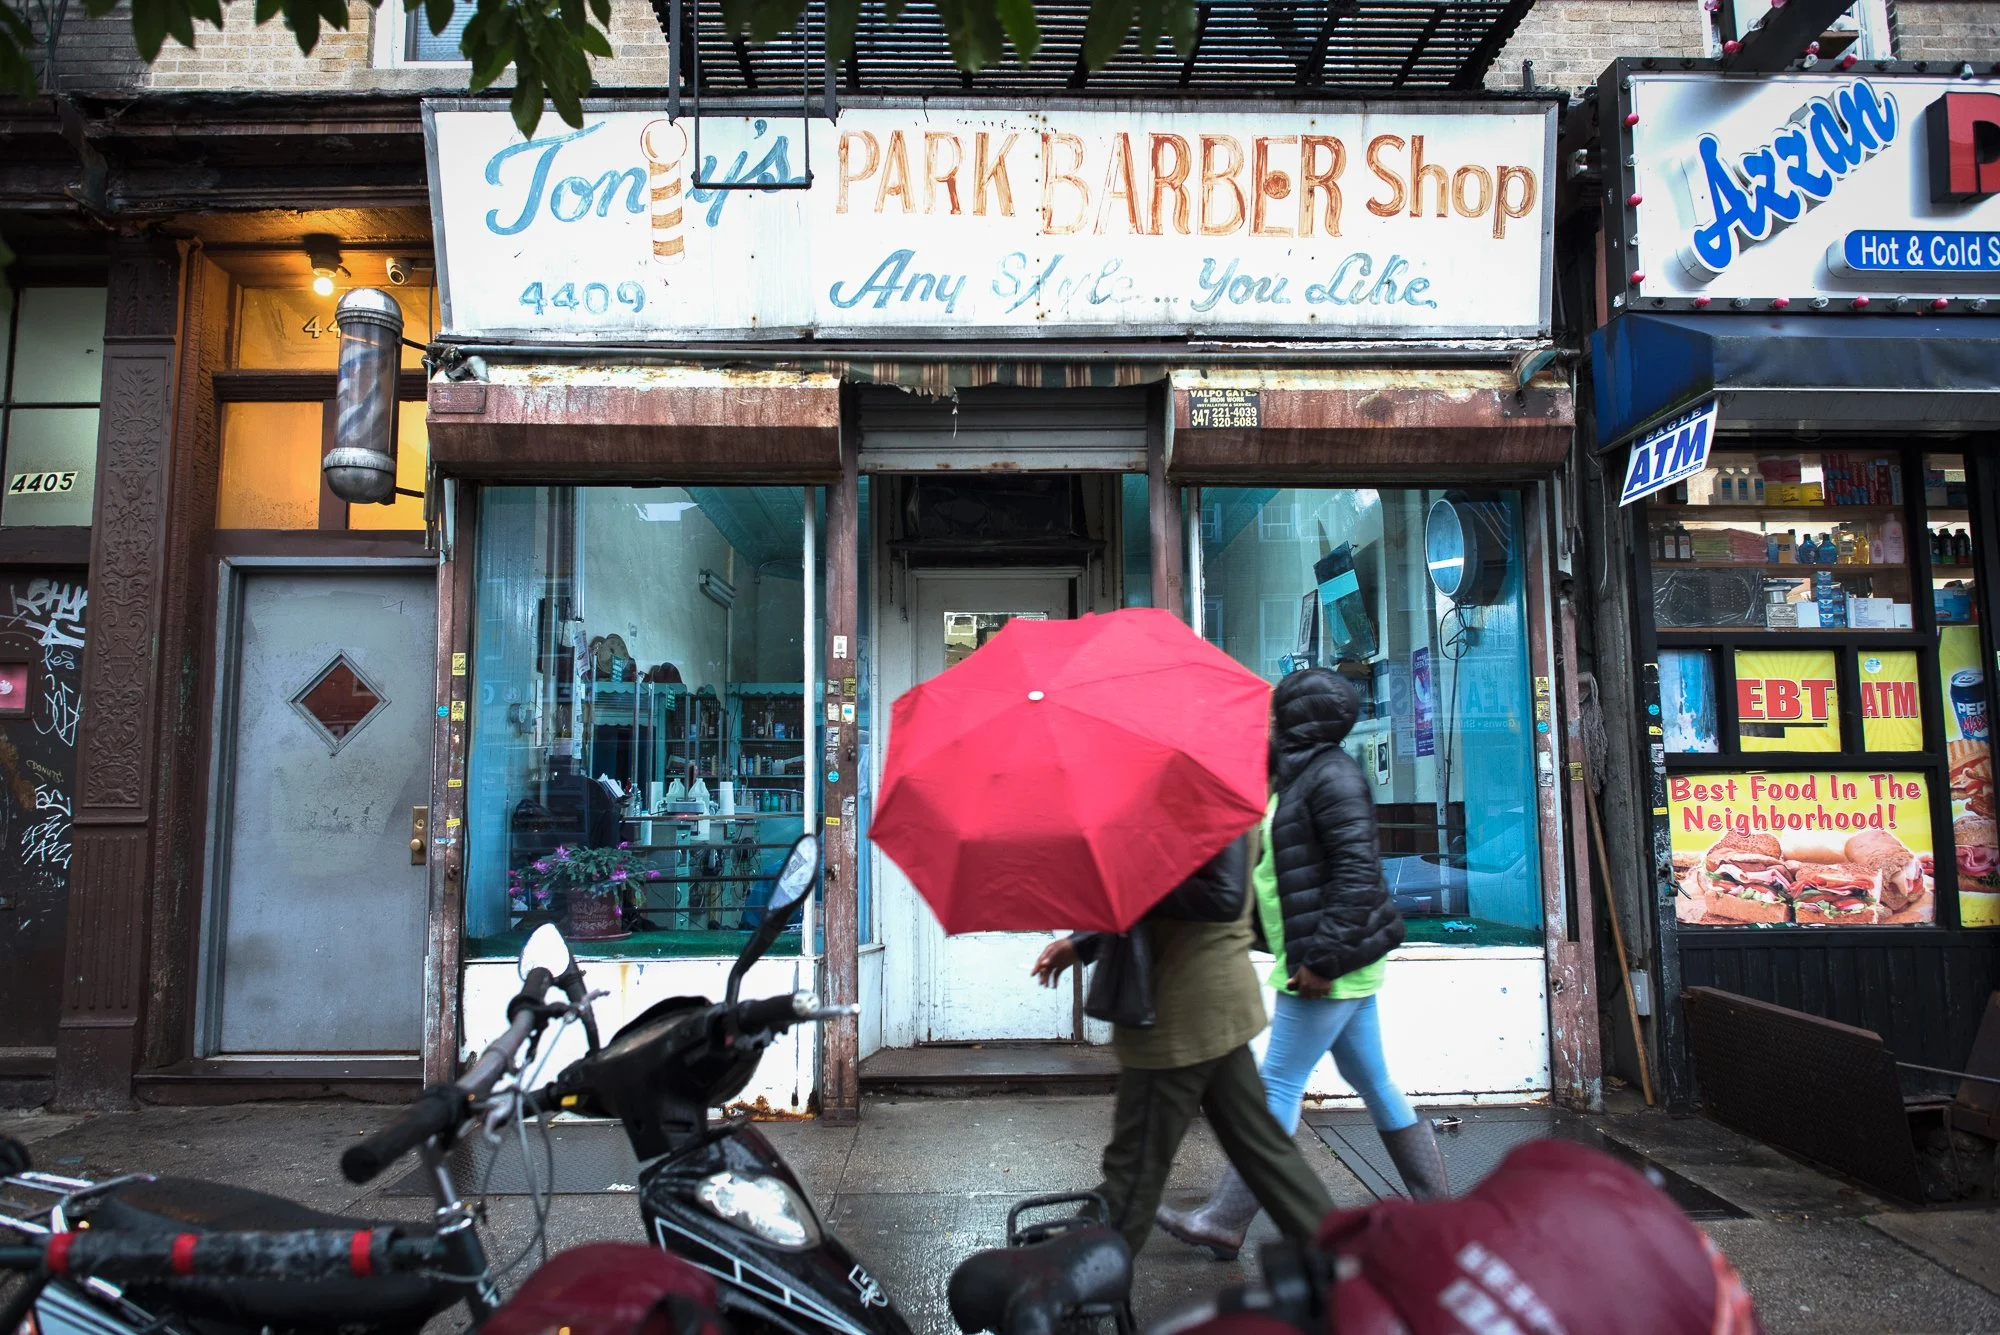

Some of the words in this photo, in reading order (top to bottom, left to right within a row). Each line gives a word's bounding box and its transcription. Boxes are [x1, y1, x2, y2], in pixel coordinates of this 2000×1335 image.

[835, 130, 1020, 217] PARK
[1040, 131, 1347, 238] BARBER
[1365, 134, 1537, 239] Shop
[1692, 78, 1897, 270] Azzan
[1861, 235, 1899, 265] Hot
[1906, 235, 1924, 266] &
[1930, 235, 1982, 267] Cold
[518, 280, 646, 316] 4409
[829, 248, 967, 314] Any
[1190, 256, 1292, 313] You
[1190, 389, 1223, 398] VALPO
[1212, 407, 1257, 418] 221-4039
[1212, 417, 1258, 428] 320-5083
[1644, 406, 1703, 443] EAGLE
[1624, 418, 1709, 494] ATM
[10, 472, 76, 493] 4405
[1737, 678, 1836, 720] EBT
[1861, 681, 1918, 719] ATM
[1669, 775, 1738, 802] Best
[1750, 774, 1818, 801] Food
[1830, 774, 1858, 800] In
[1867, 773, 1923, 800] The
[1682, 803, 1898, 838] Neighborhood!
